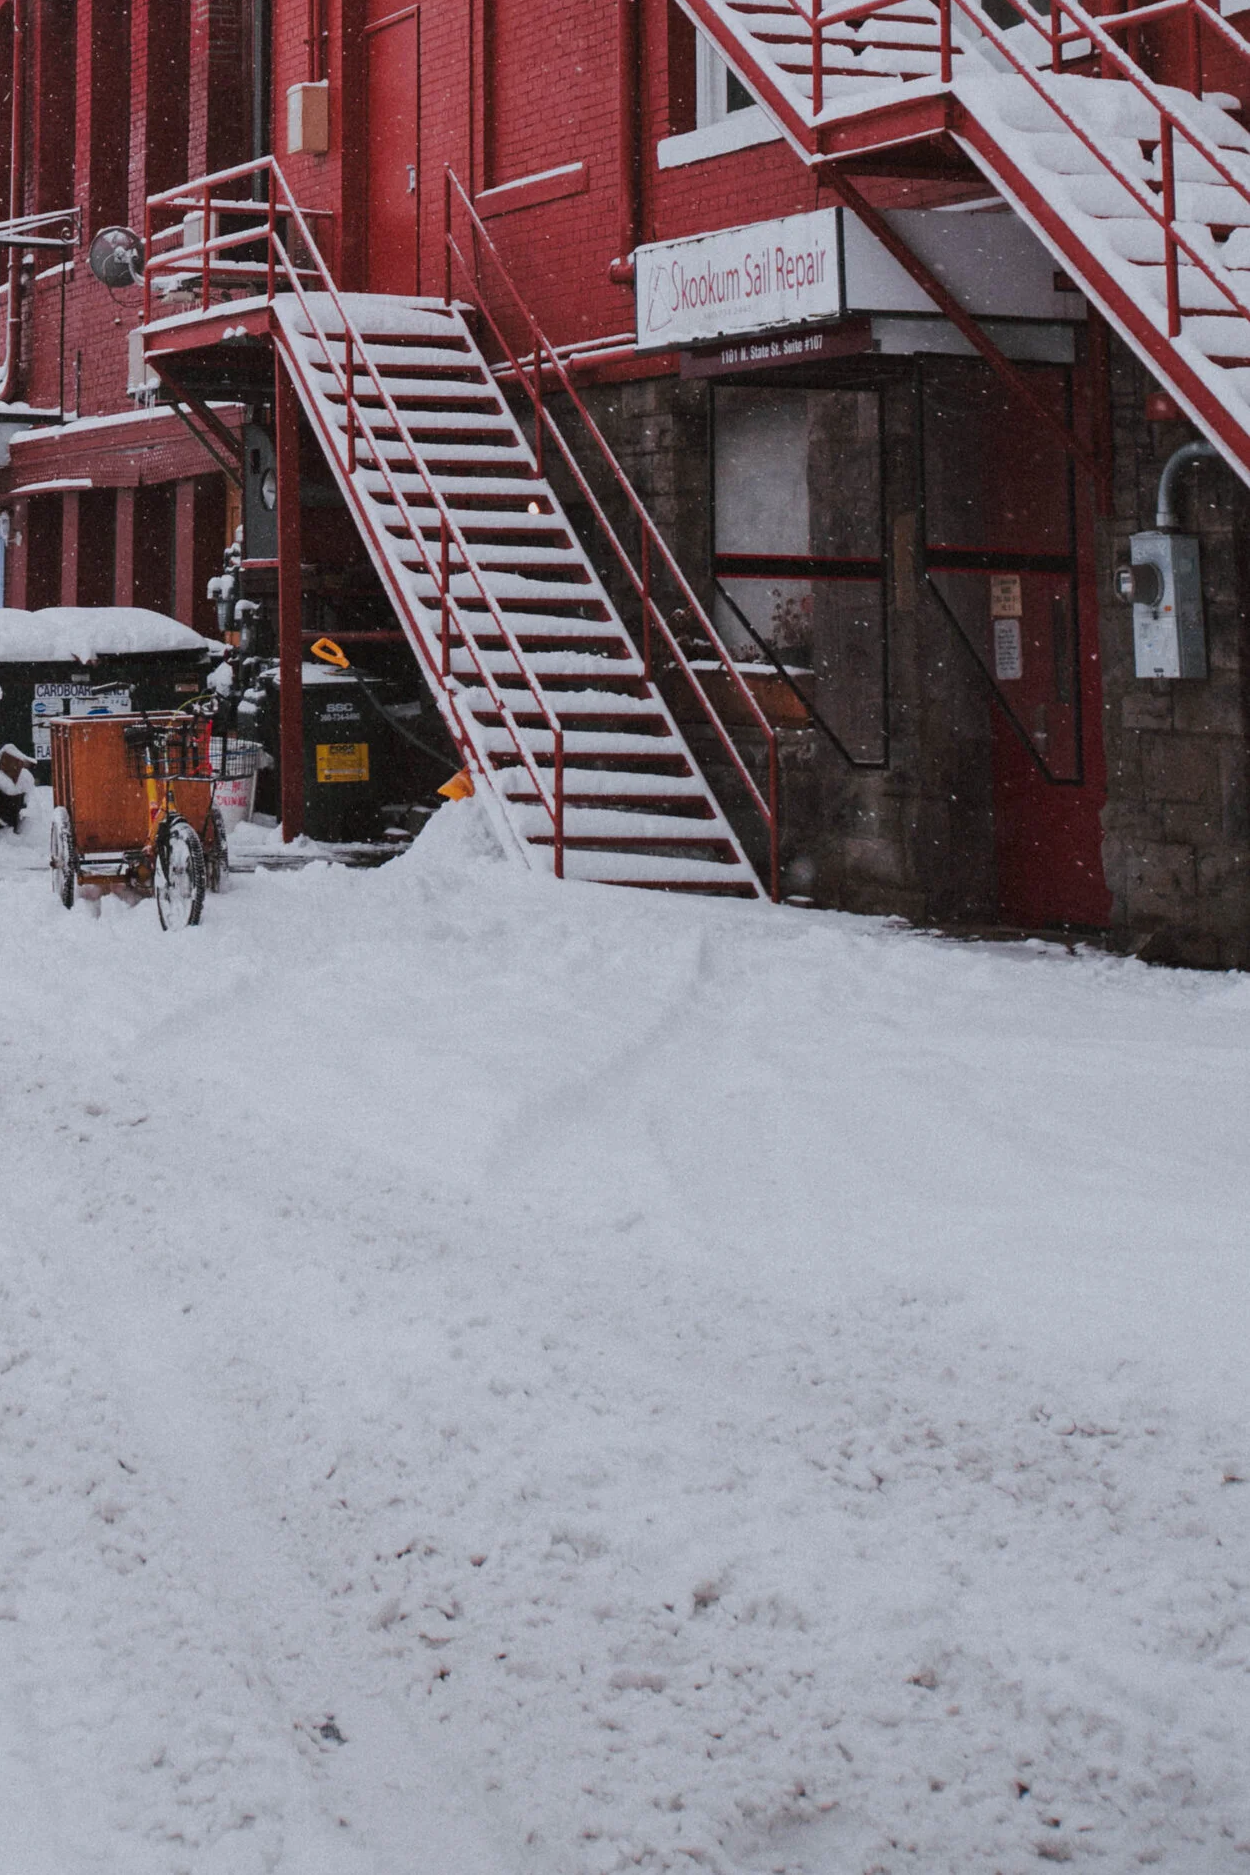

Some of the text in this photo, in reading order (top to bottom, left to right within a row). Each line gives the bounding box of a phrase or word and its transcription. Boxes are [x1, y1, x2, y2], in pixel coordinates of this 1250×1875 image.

[671, 240, 826, 312] Skookum Sail Repair
[721, 349, 738, 364] 1101
[750, 345, 769, 360] State
[770, 342, 782, 357] St.
[783, 339, 803, 355] Suite
[804, 335, 823, 351] #107
[36, 684, 93, 698] CARDBOAR
